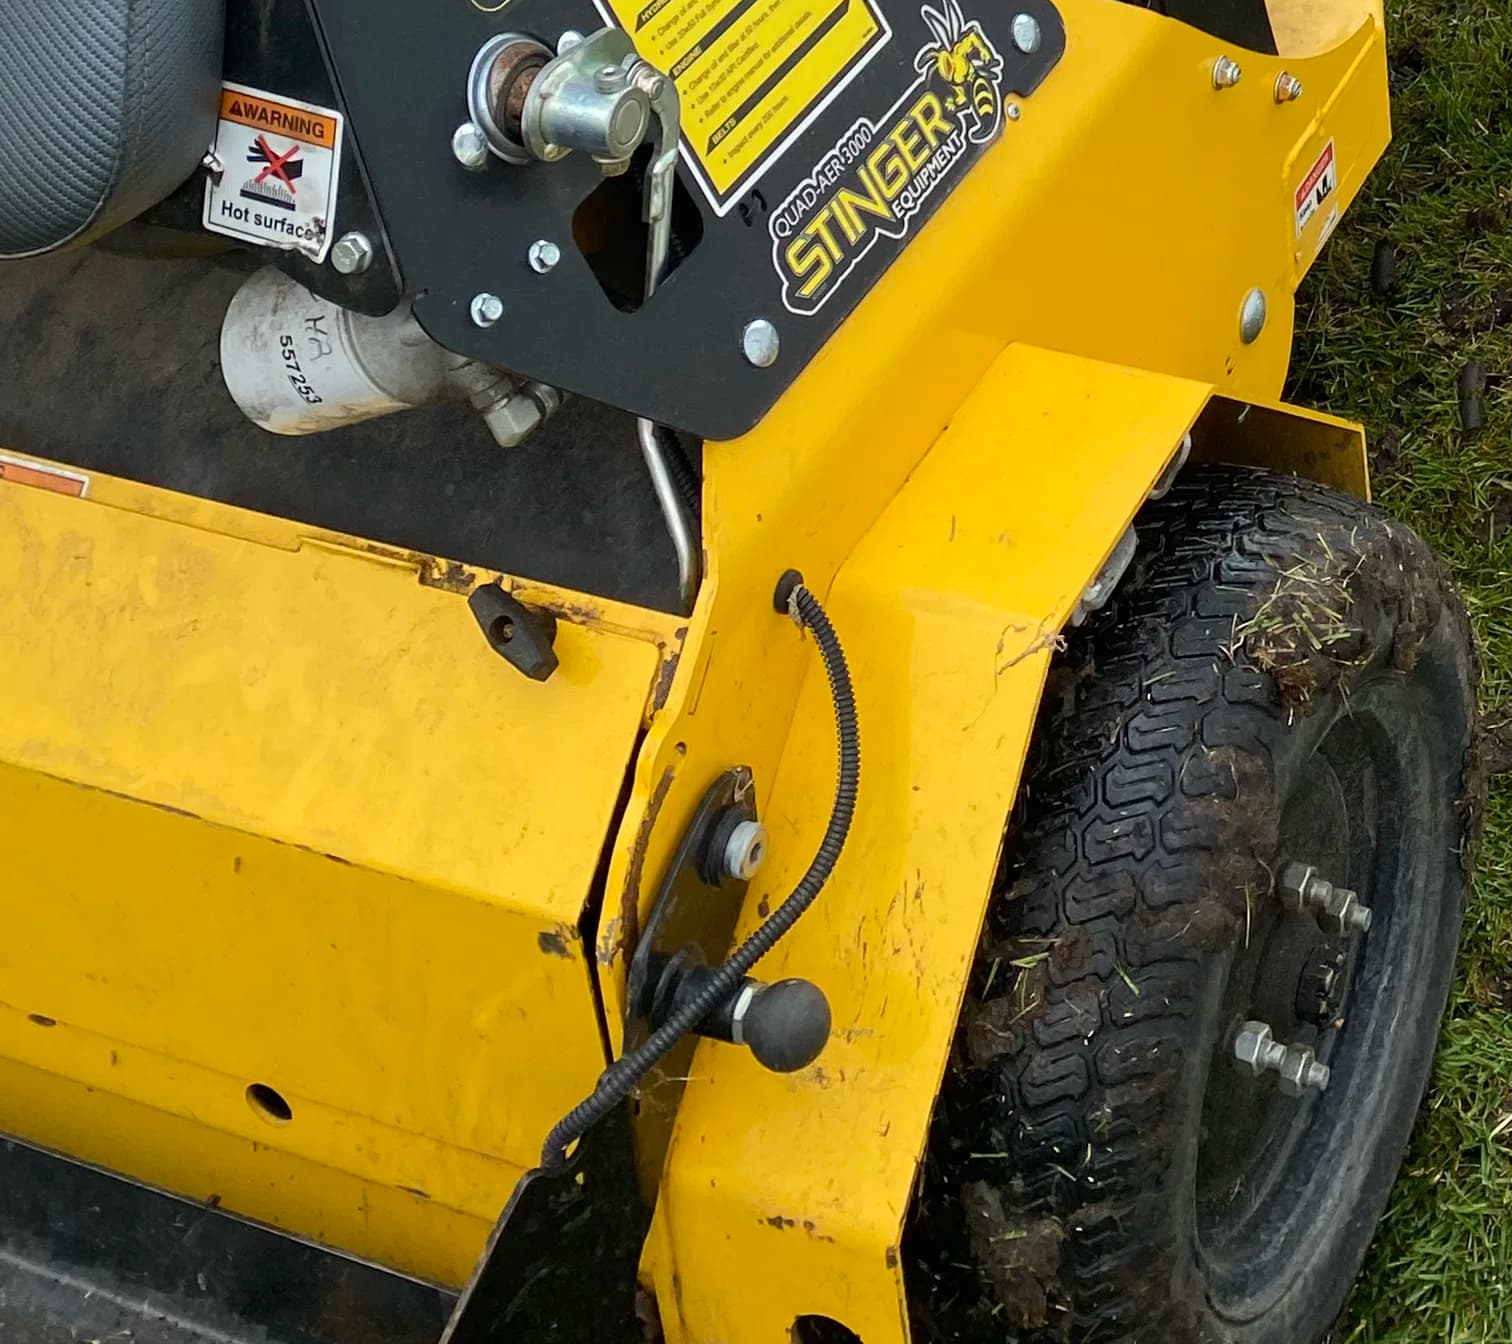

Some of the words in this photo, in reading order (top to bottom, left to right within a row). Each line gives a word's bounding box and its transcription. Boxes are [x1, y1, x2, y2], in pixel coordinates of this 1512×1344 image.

[671, 44, 702, 77] ENGINE
[243, 100, 325, 139] WARNING
[711, 115, 737, 145] BELTS
[775, 160, 845, 237] QUAD-AER
[843, 125, 873, 165] 3000
[784, 91, 956, 298] STINGER
[890, 132, 963, 219] EQUIPMENT
[221, 199, 250, 223] Hot
[253, 211, 314, 242] surface
[279, 334, 324, 406] 557253
